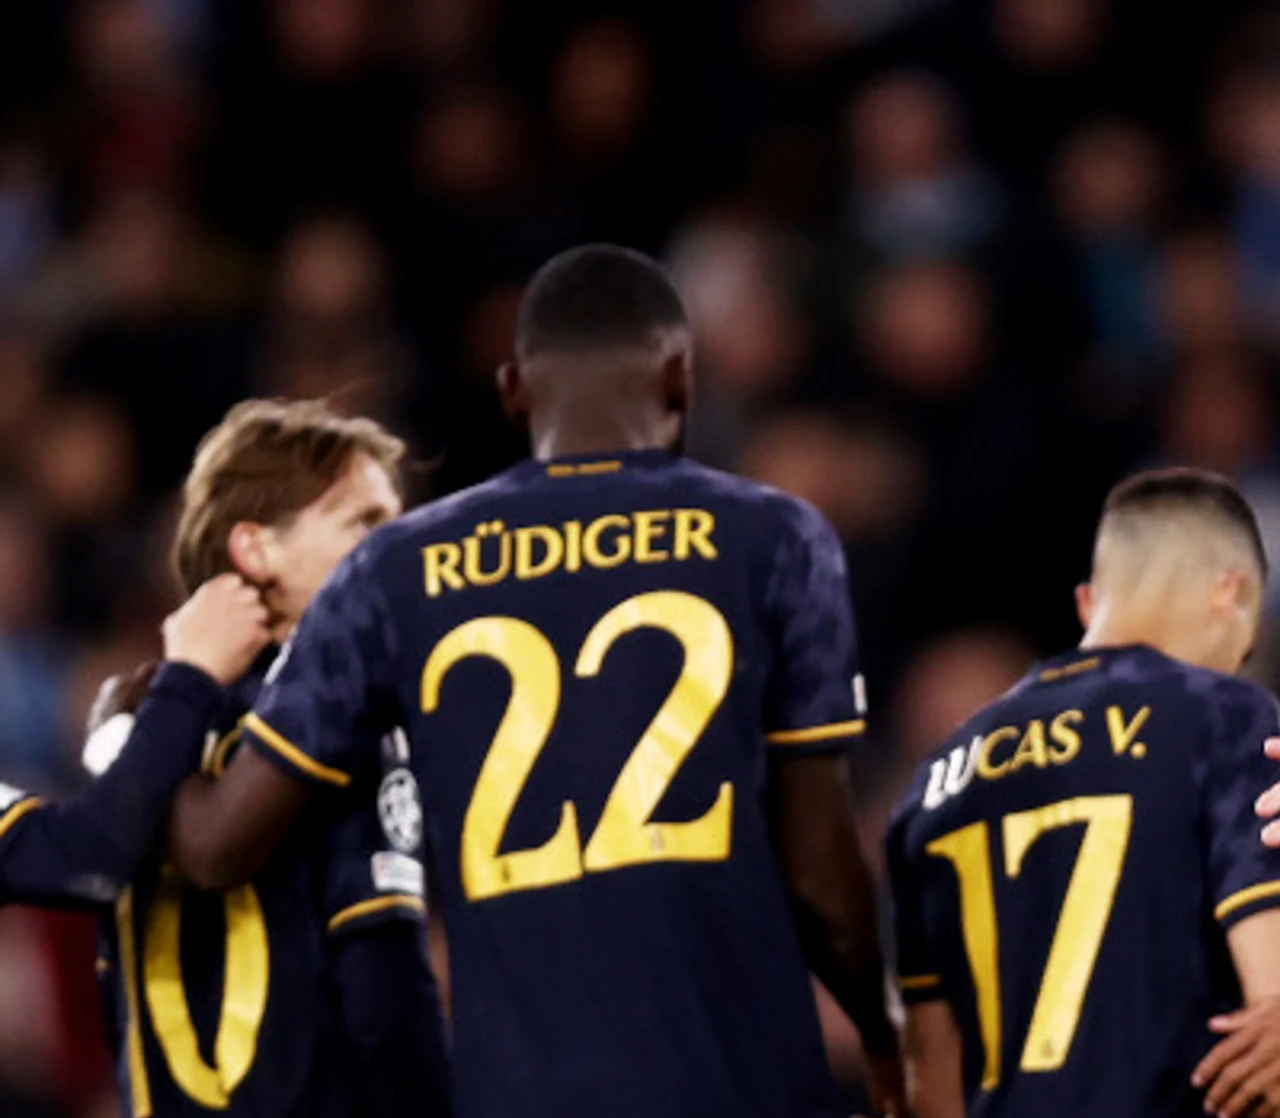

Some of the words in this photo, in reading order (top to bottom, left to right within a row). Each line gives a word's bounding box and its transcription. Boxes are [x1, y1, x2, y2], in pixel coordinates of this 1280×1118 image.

[421, 508, 718, 597] RÜDIGER
[420, 590, 734, 902] 22
[922, 709, 1085, 811] LUCAS
[1105, 705, 1152, 759] V.
[925, 793, 1134, 1092] 17
